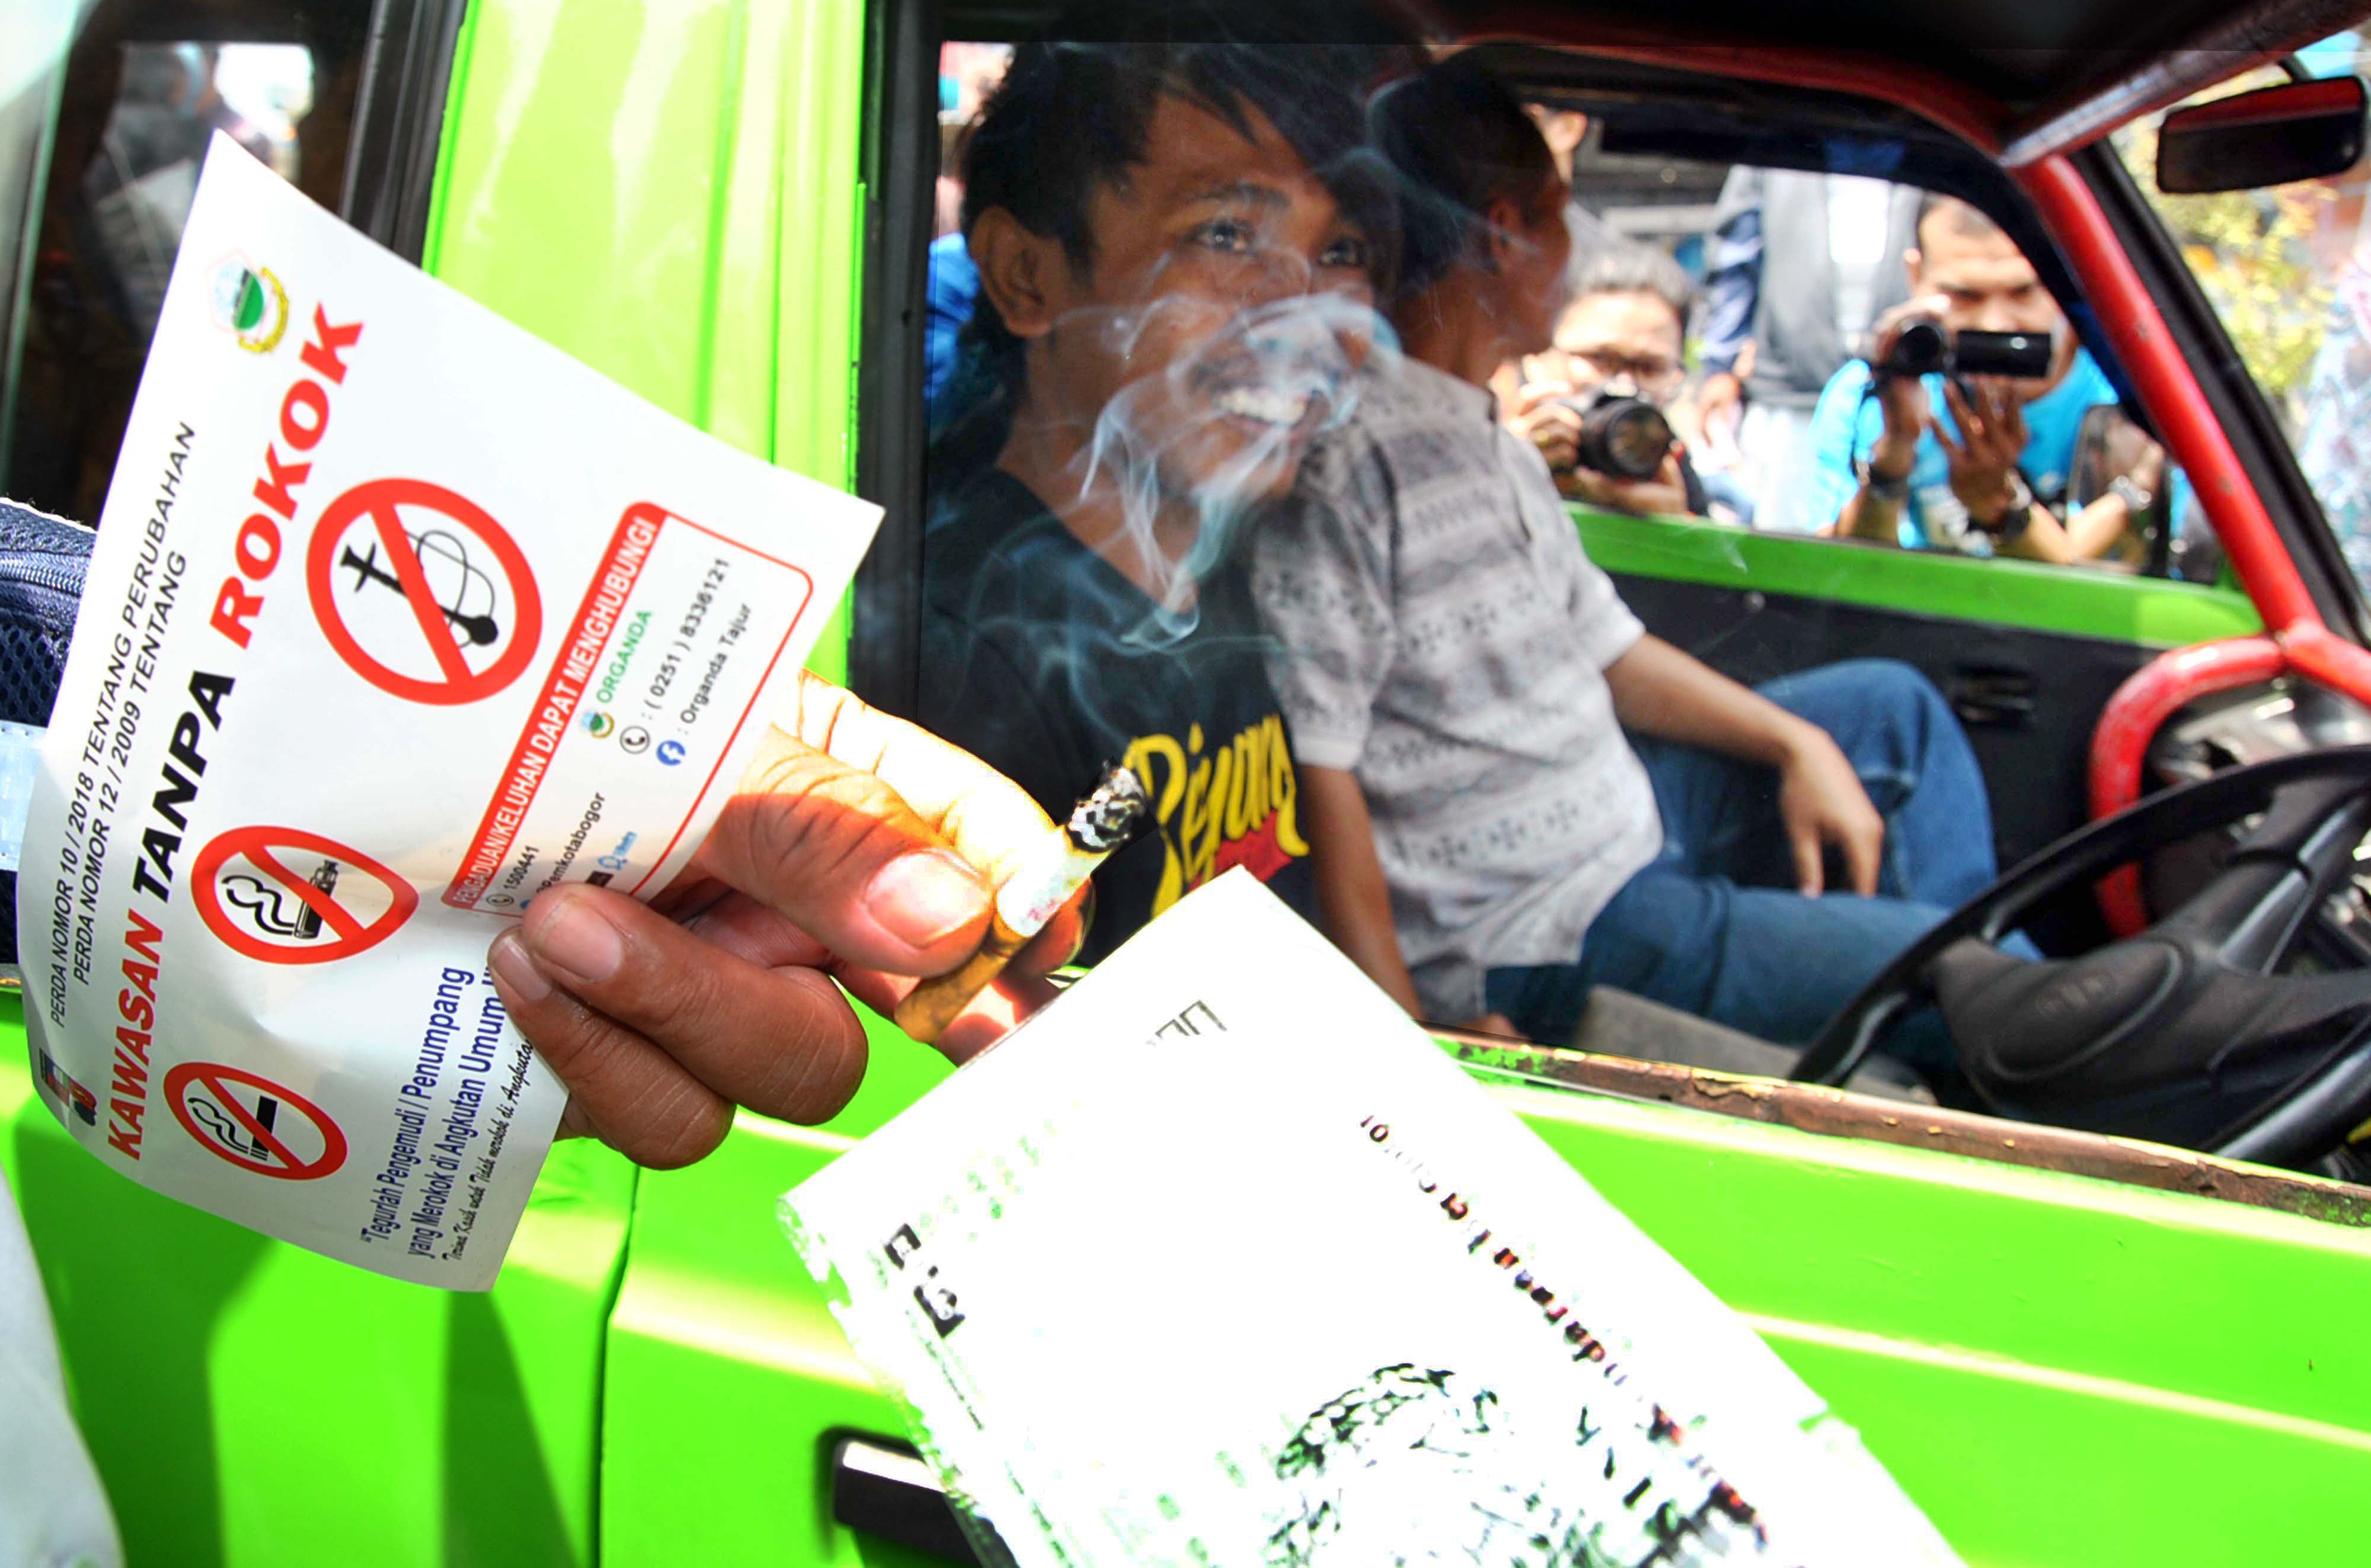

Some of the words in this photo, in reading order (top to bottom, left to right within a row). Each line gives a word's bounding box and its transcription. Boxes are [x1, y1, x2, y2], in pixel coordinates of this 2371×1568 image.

[209, 300, 364, 650] ROKOK
[122, 421, 194, 629] PERUBAHAN
[130, 551, 186, 693] TENTANG
[596, 610, 652, 703] ORGANDA
[83, 633, 131, 766] TENTANG
[680, 652, 728, 724] Organda
[718, 603, 751, 646] Tajur
[111, 700, 140, 768] 2009
[452, 751, 547, 904] PENGADUAN/KELUHAN
[531, 680, 579, 754] DAPAT
[563, 516, 657, 684] MENGHUBUNGI
[69, 772, 94, 834] 2018
[99, 782, 118, 813] 12
[107, 765, 122, 784] /
[132, 670, 236, 904] TANPA
[60, 847, 78, 875] 10
[65, 831, 81, 849] /
[79, 818, 110, 913] NOMOR
[52, 879, 74, 963] NOMOR
[74, 913, 95, 986] PERDA
[50, 962, 67, 1029] PERDA
[107, 907, 164, 1160] KAWASAN
[401, 967, 475, 1100] Penumpang
[458, 997, 506, 1073] Umum
[376, 1106, 427, 1188] Pengemudi
[434, 1078, 485, 1157] Angkutan
[411, 1172, 455, 1229] Merokok
[430, 1151, 461, 1172] di
[408, 1221, 443, 1259] yang
